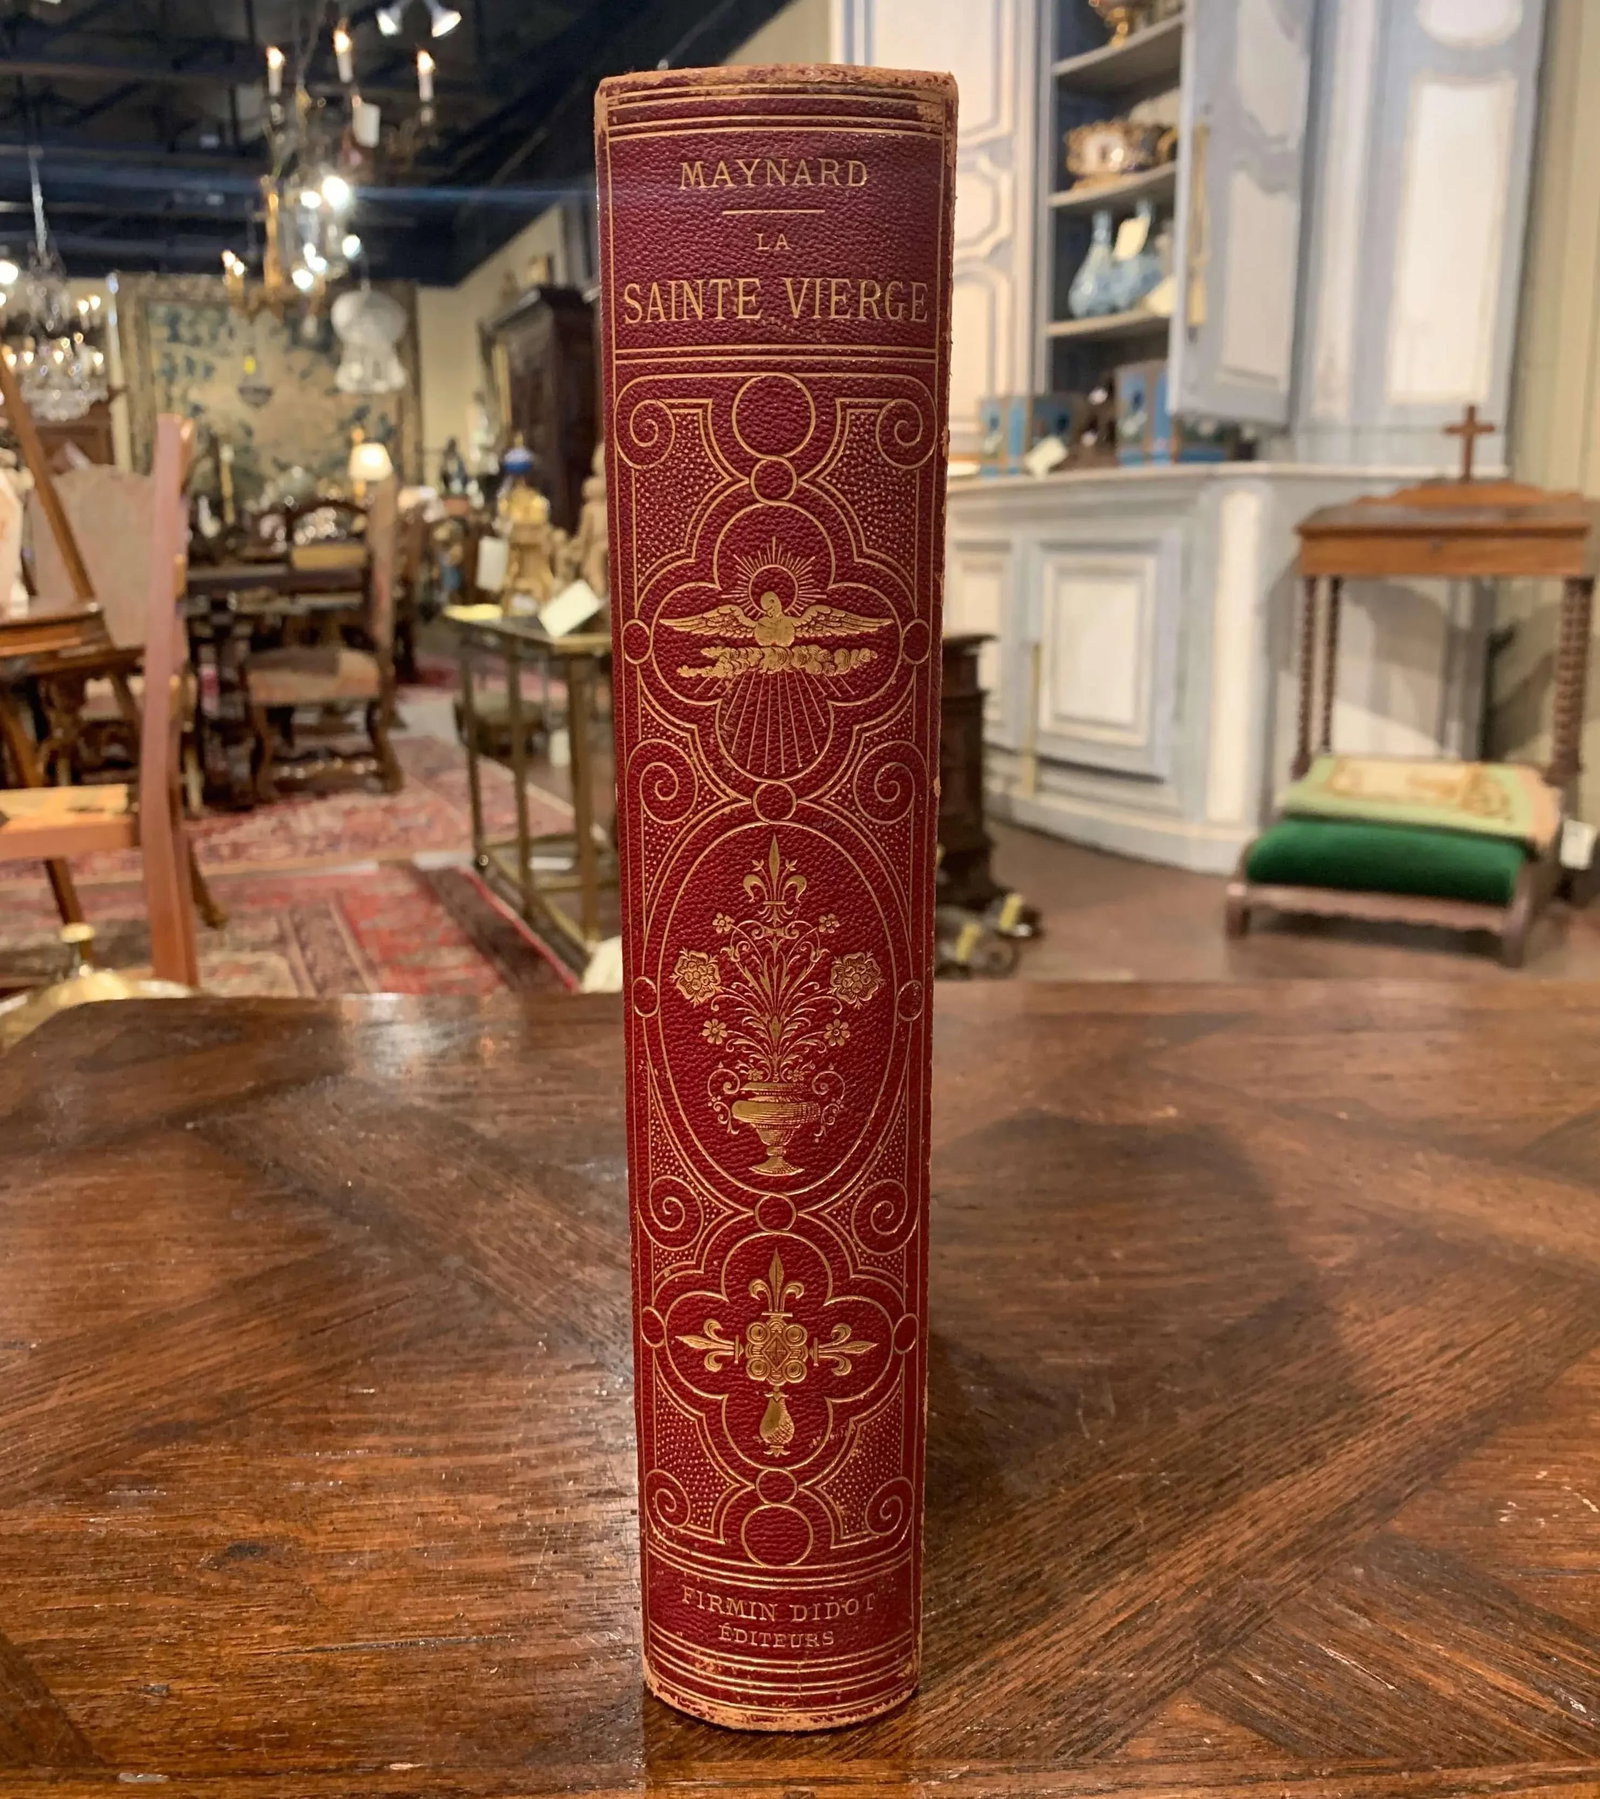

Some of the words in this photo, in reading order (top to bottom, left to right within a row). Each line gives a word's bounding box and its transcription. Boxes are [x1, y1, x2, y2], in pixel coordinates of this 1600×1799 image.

[679, 158, 868, 189] MAYNARD
[756, 233, 792, 250] LA
[623, 277, 762, 324] SAINTE
[781, 277, 928, 322] VIERGE
[682, 1585, 778, 1622] FIRMIN
[790, 1593, 875, 1622] DIDOT
[719, 1622, 834, 1648] ÉDITEURS
